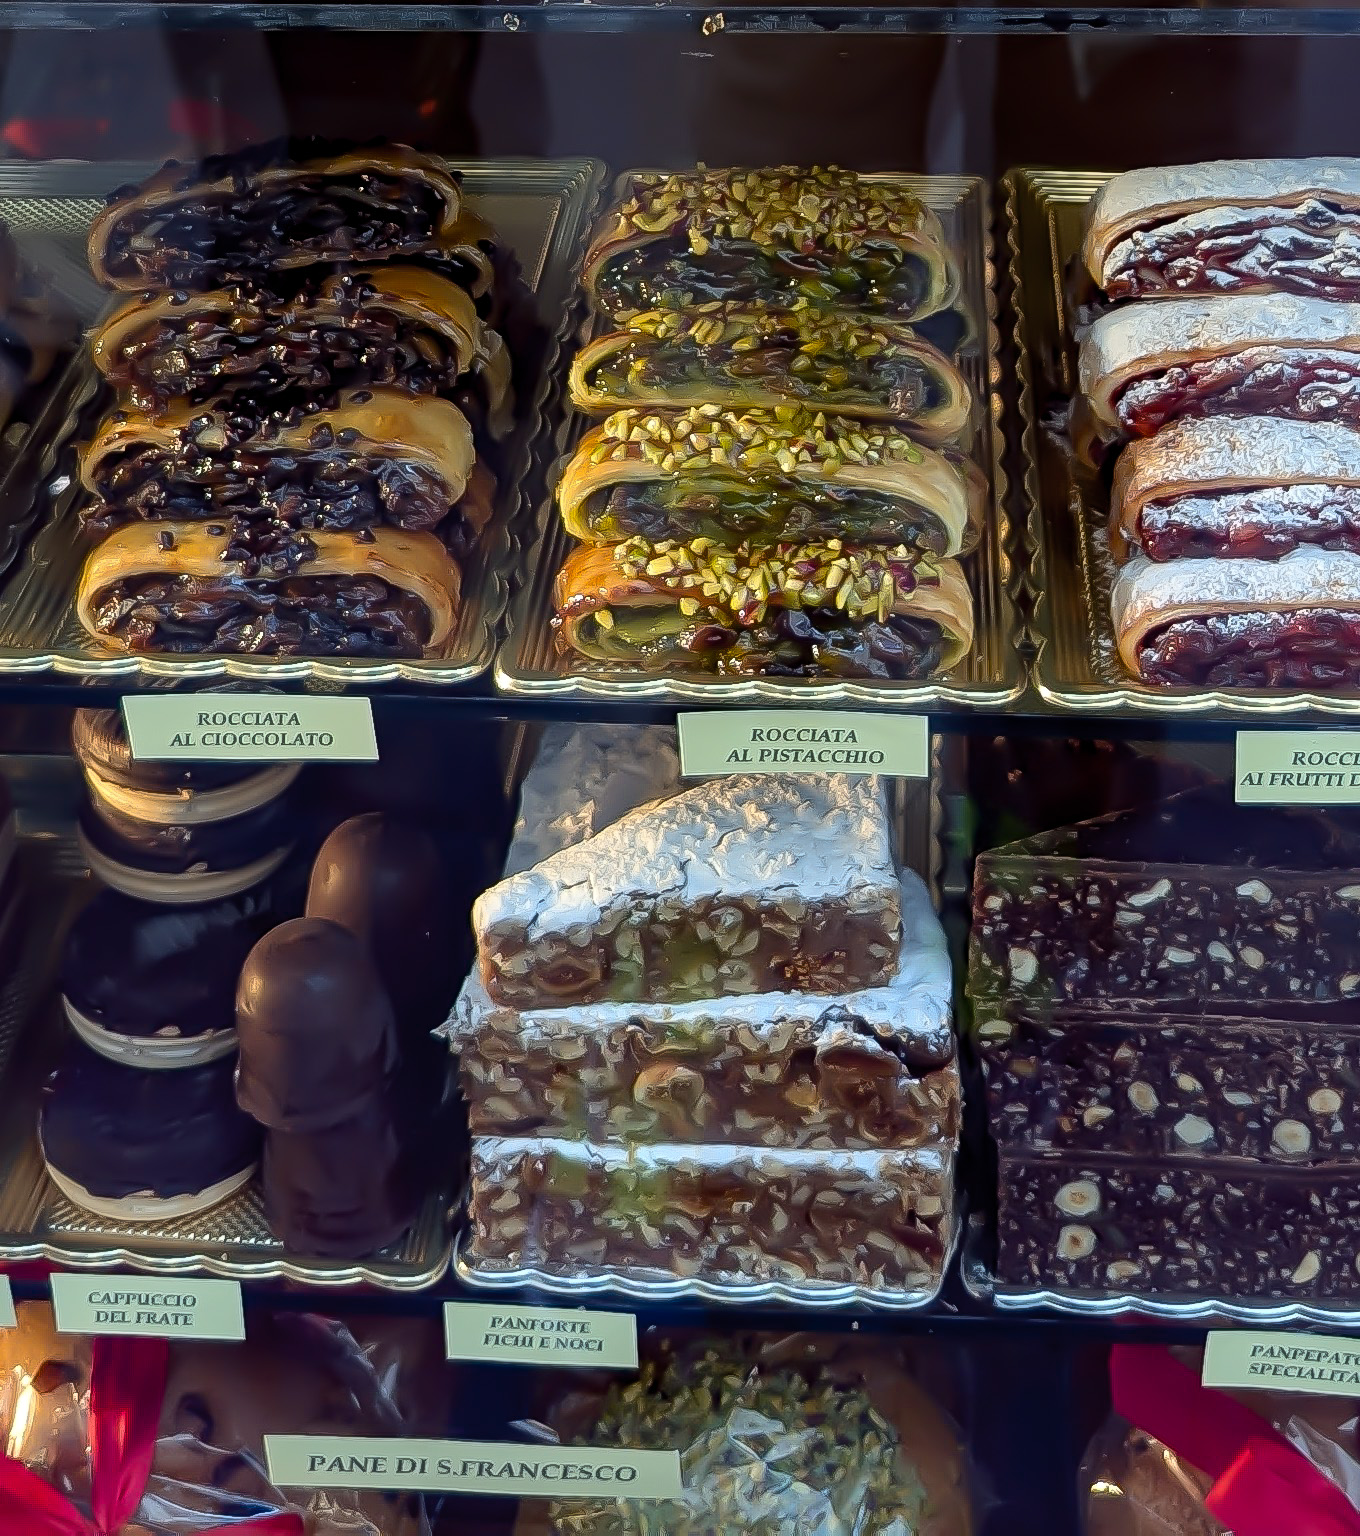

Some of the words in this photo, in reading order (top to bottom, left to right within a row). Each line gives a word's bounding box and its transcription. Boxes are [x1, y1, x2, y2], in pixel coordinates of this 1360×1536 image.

[196, 712, 301, 726] ROCCIATA
[169, 732, 196, 747] AL
[201, 732, 335, 747] CIOCCOLATO
[750, 728, 859, 744] ROCCIATA
[725, 748, 753, 763] AL
[758, 748, 886, 765] PISTACCHIO
[1239, 772, 1264, 787] AI
[1268, 772, 1346, 787] FRUTTI
[87, 1291, 197, 1307] CAPPUCCIO
[94, 1309, 132, 1323] DEL
[134, 1310, 194, 1326] FRATE
[489, 1316, 592, 1335] PANFORTE
[482, 1333, 534, 1349] FICHI
[538, 1335, 551, 1349] E
[554, 1336, 605, 1352] NOCI
[306, 1454, 388, 1473] PANE
[394, 1456, 429, 1474] DI
[436, 1458, 639, 1482] S.FRANCESCO
